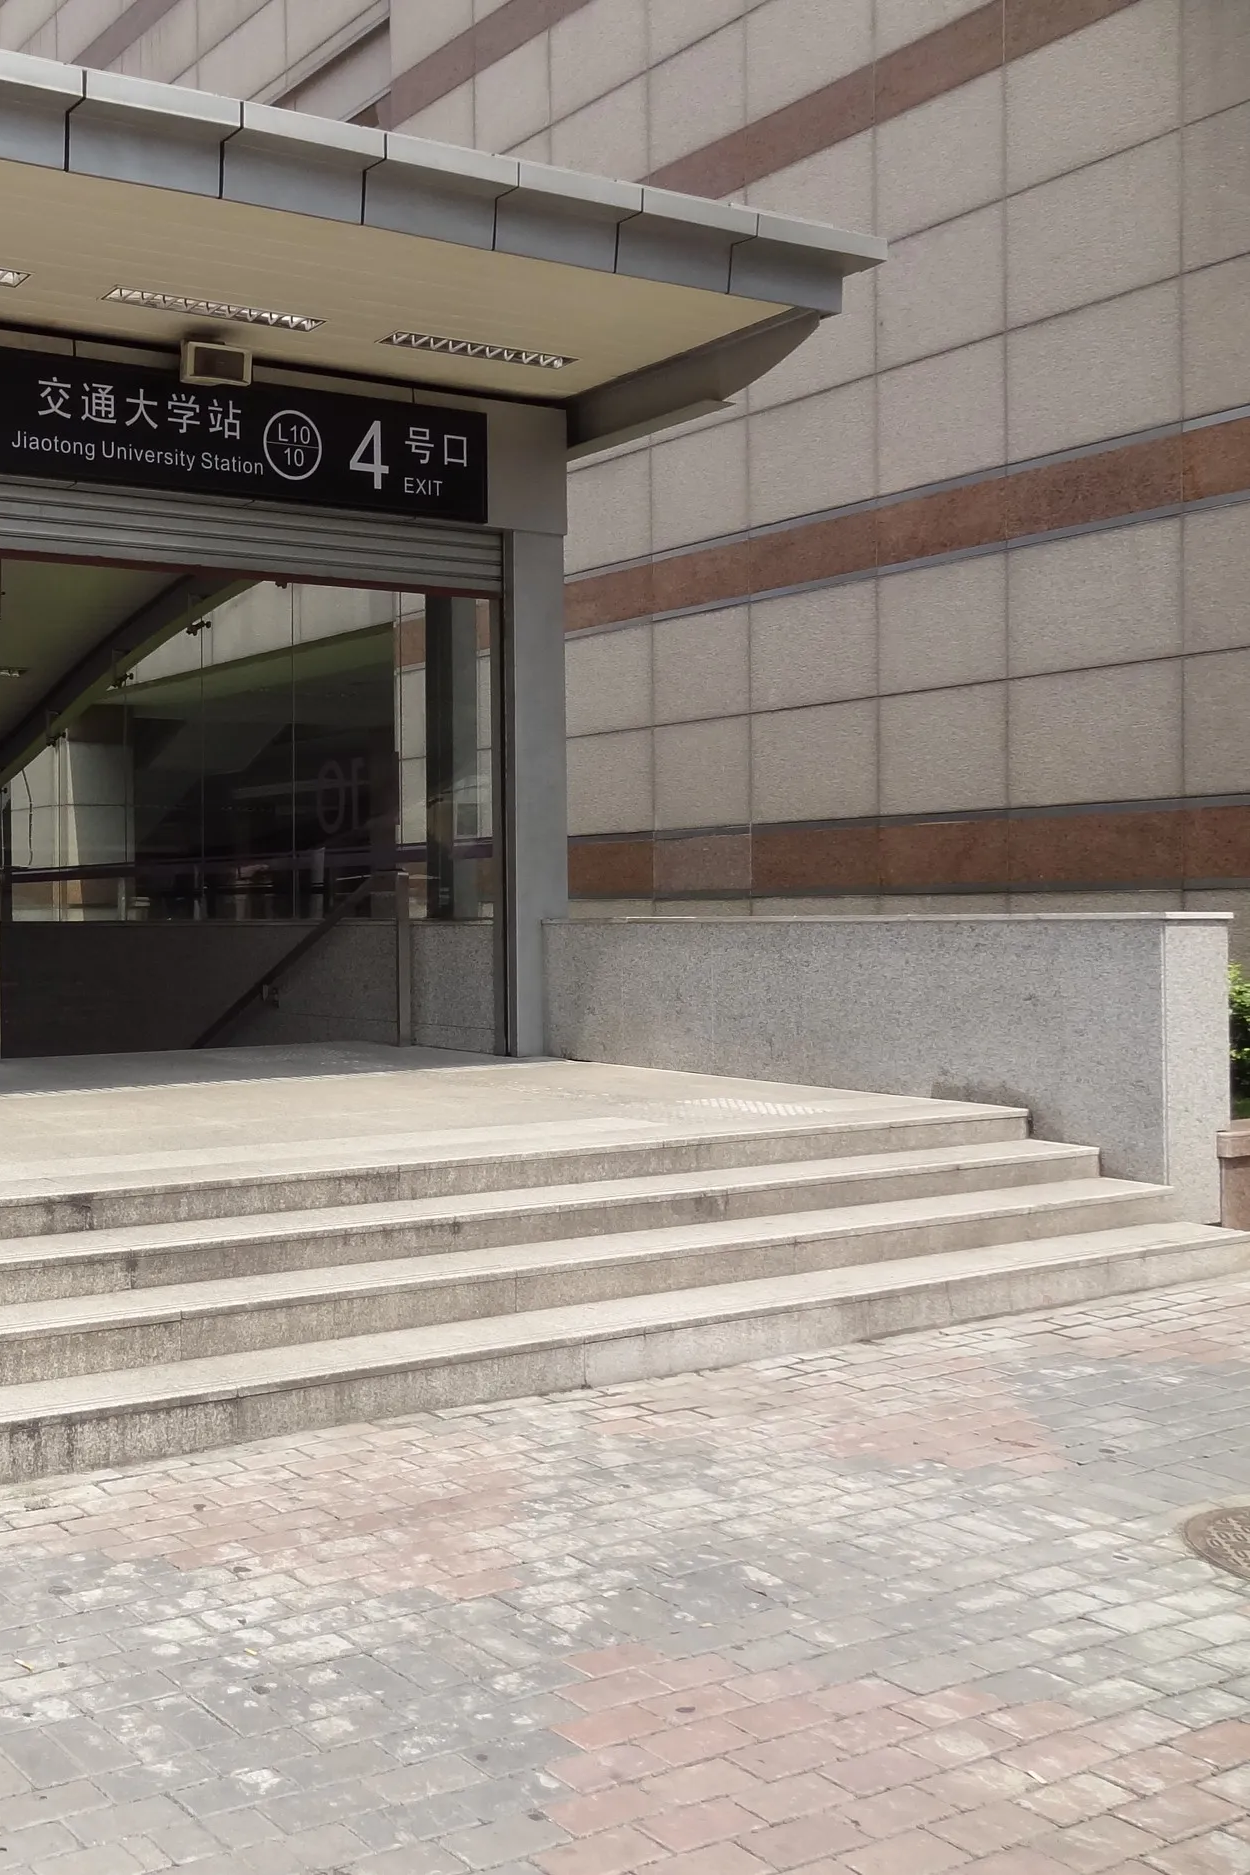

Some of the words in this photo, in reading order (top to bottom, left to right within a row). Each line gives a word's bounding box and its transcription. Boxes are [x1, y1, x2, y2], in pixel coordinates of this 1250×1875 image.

[37, 376, 242, 440] 交通大学站
[11, 430, 96, 461] Jiaotong
[101, 440, 196, 472] University
[200, 451, 264, 476] Station
[278, 423, 311, 445] L10
[349, 420, 390, 490] 4
[404, 426, 468, 468] 号口
[283, 447, 305, 467] 10
[403, 477, 443, 497] EXIT
